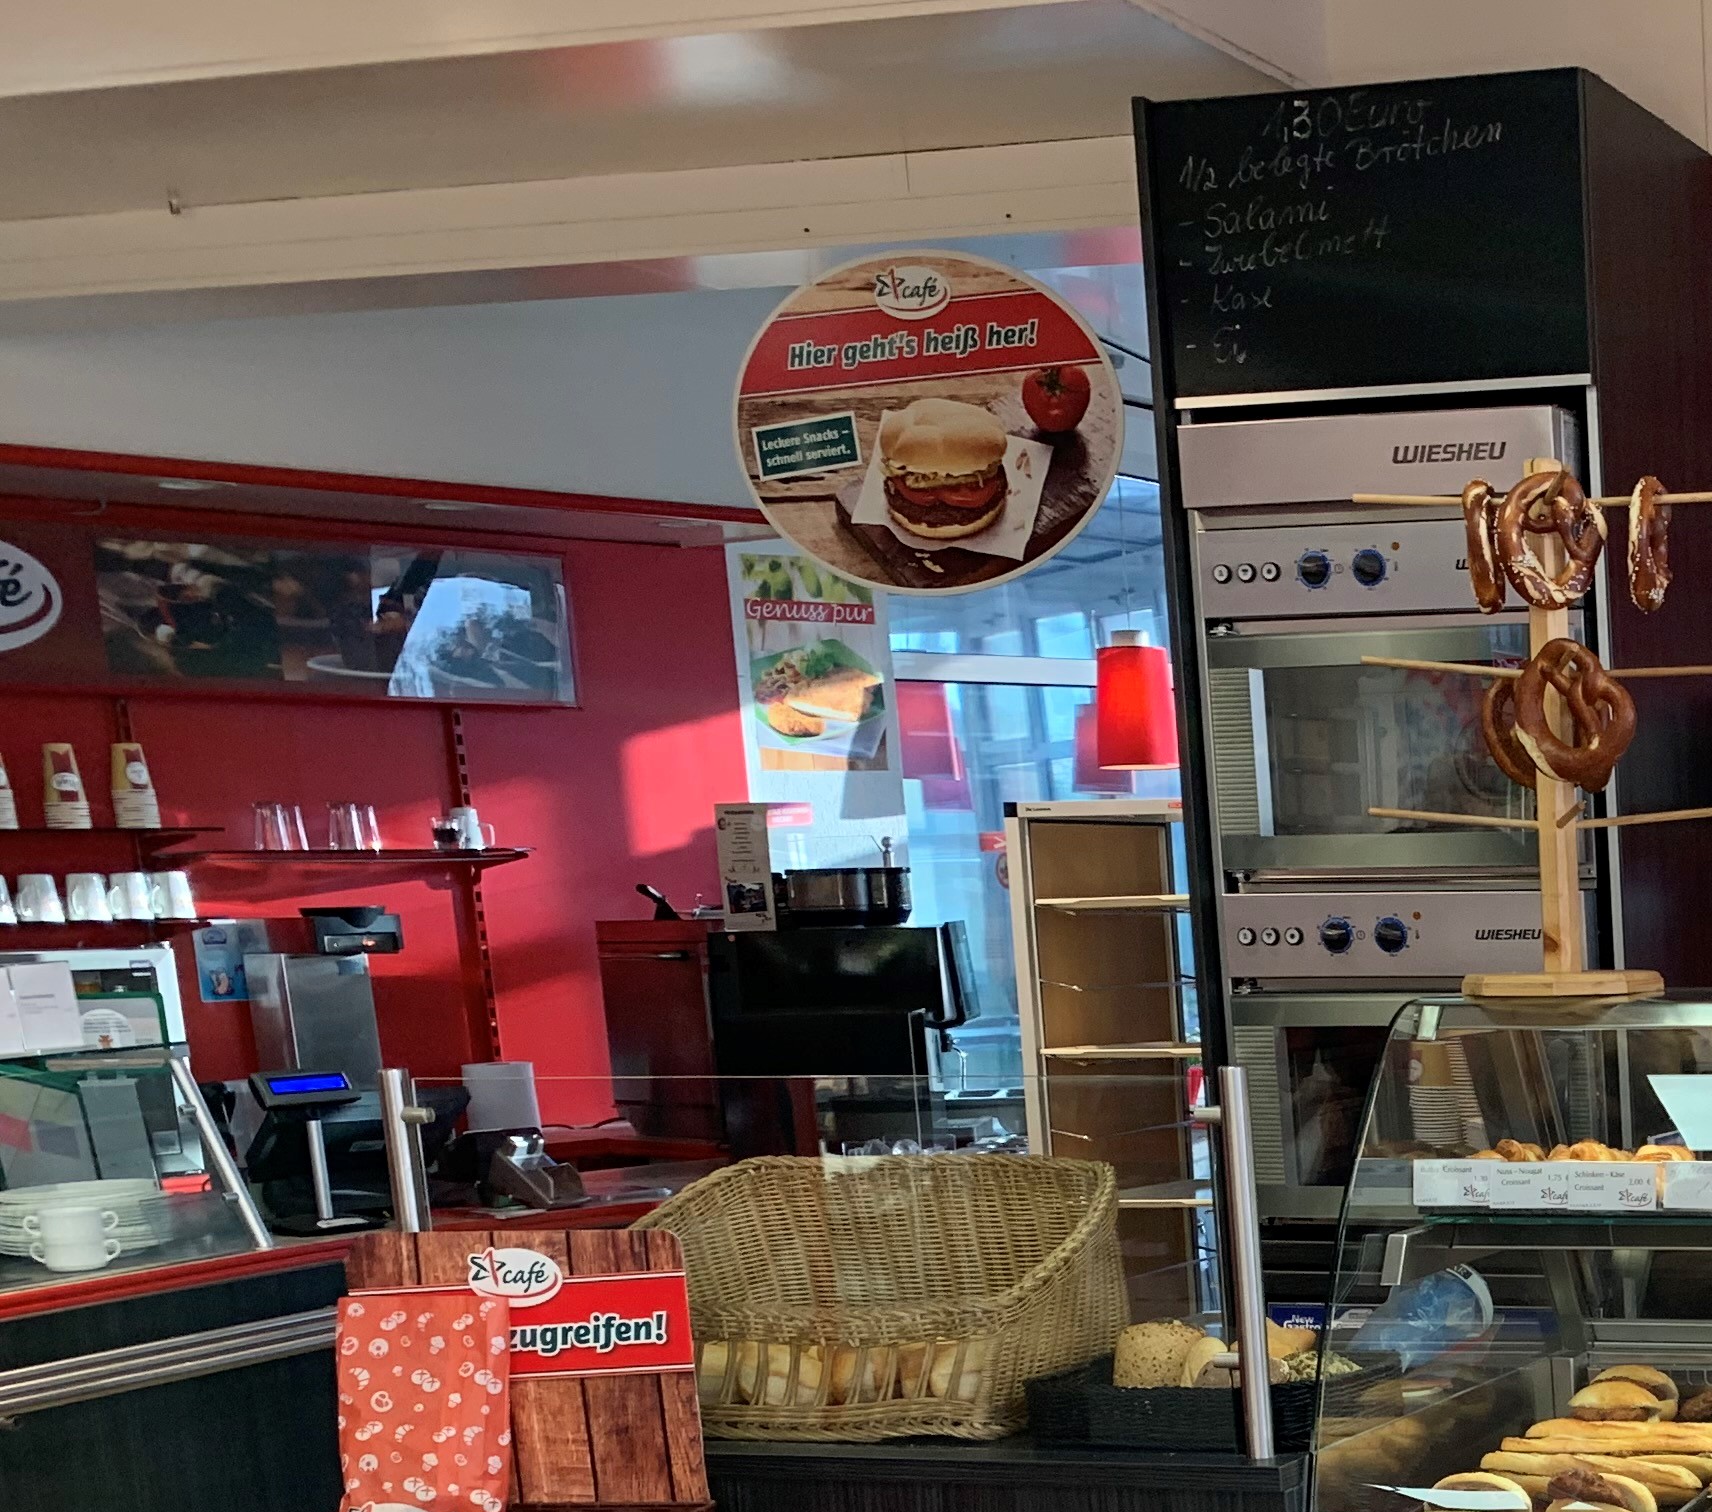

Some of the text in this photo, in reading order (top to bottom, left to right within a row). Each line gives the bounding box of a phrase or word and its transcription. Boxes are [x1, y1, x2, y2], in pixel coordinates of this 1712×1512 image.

[901, 286, 940, 306] café
[788, 344, 836, 369] Hier
[924, 327, 978, 355] heiß
[986, 321, 1038, 348] her!
[762, 429, 840, 452] Leckere Snacks
[766, 450, 803, 467] schnell
[1393, 441, 1507, 465] WIESHEU
[747, 598, 873, 626] Genuss pur
[1474, 928, 1542, 941] WIESHEU
[503, 1260, 548, 1293] café
[508, 1313, 666, 1353] zugreifen!
